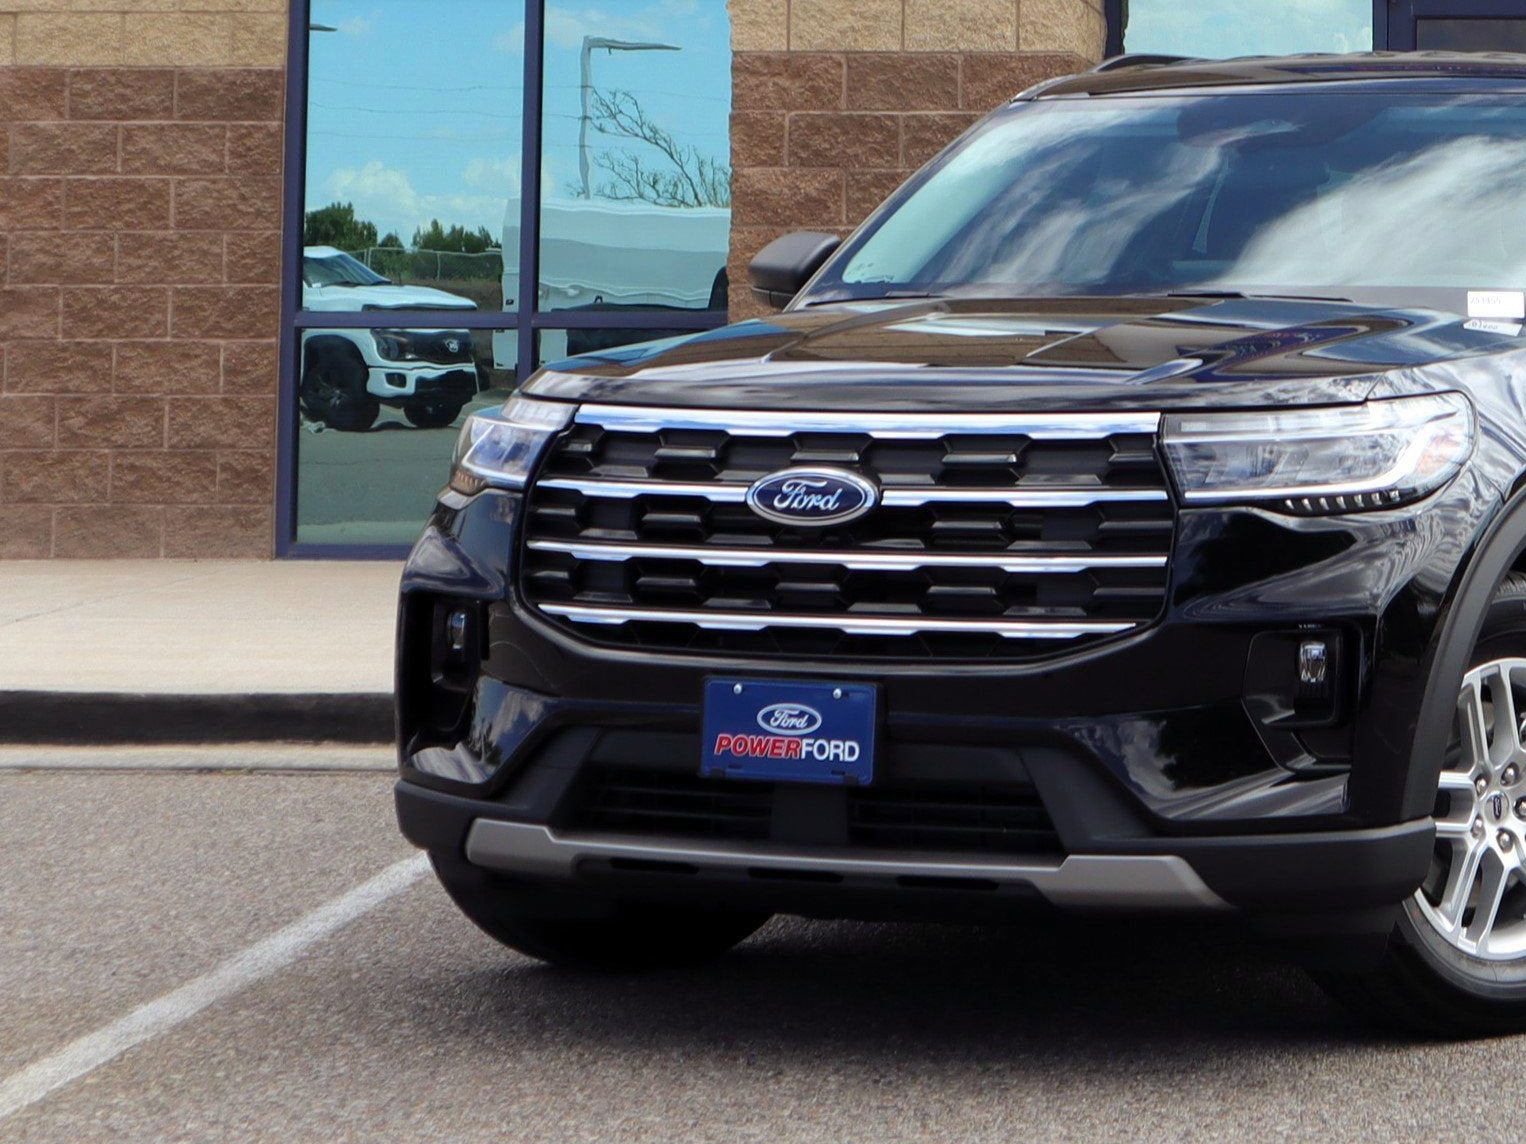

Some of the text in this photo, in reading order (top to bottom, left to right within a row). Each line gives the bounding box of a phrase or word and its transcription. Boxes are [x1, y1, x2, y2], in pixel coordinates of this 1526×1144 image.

[773, 478, 843, 511] Ford
[769, 708, 811, 729] Ford
[714, 733, 860, 762] POWERFORD
